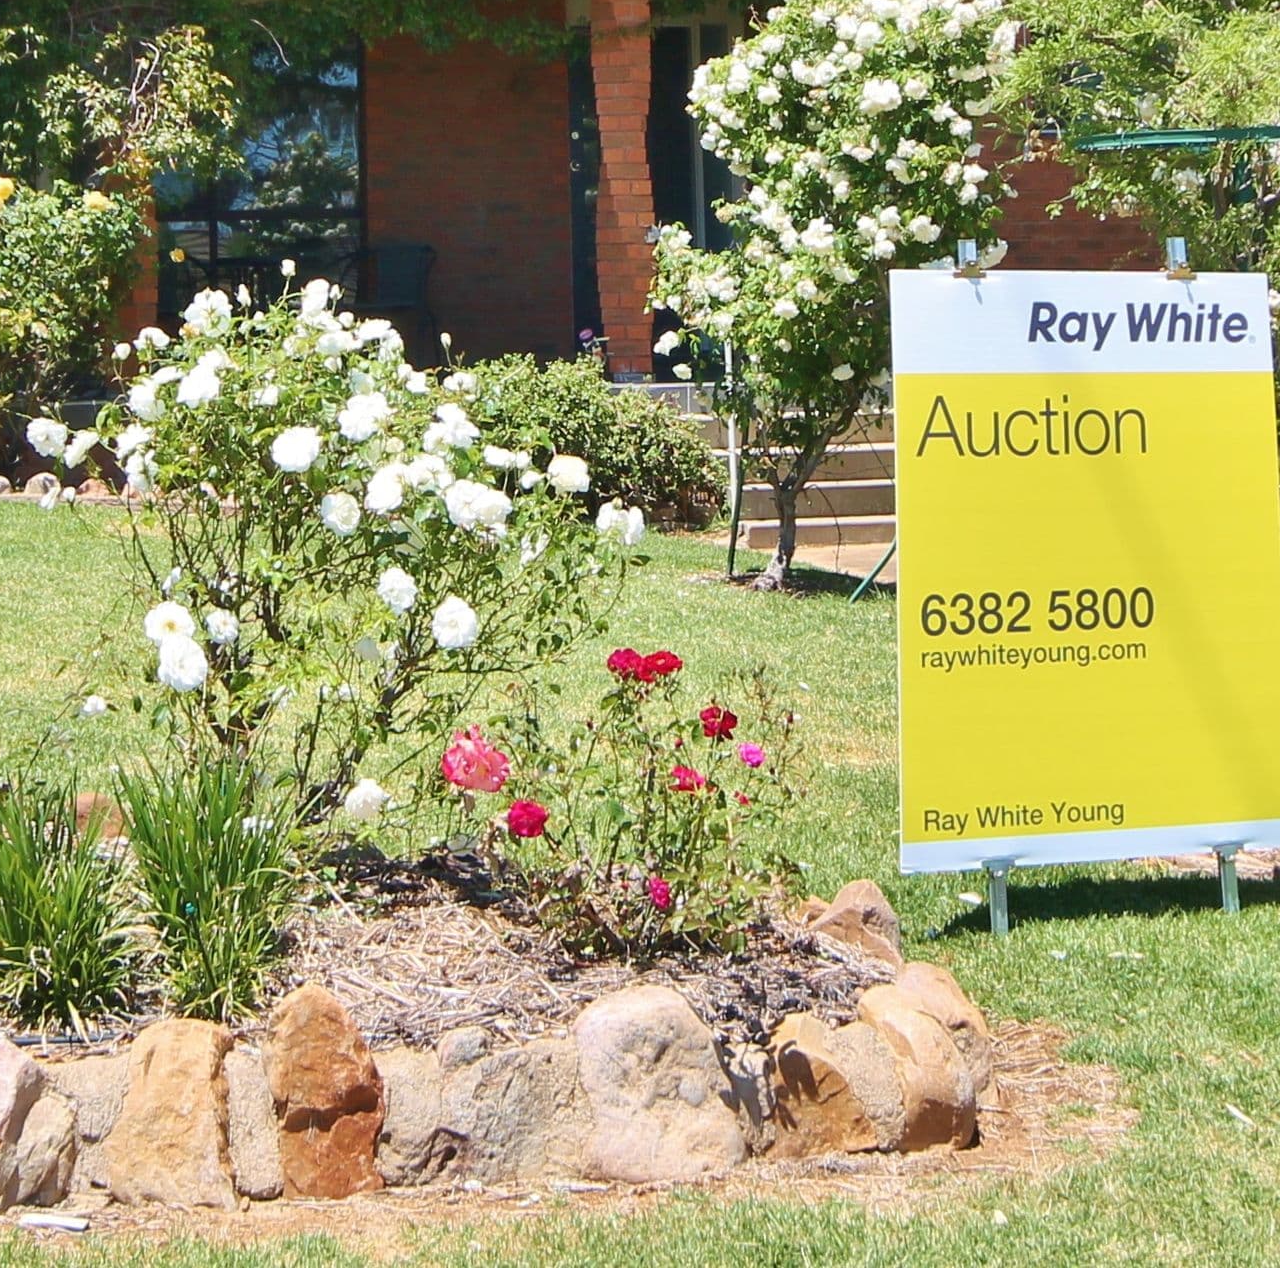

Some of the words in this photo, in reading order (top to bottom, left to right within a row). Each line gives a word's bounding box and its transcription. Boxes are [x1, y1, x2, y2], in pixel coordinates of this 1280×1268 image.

[1027, 301, 1117, 352] Ray
[1125, 302, 1249, 344] White
[916, 394, 1147, 458] Auction
[921, 590, 1032, 637] 6382
[1048, 586, 1154, 632] 5800
[921, 642, 1147, 673] raywhiteyoung.com
[924, 809, 969, 836] Ray
[976, 804, 1044, 829] White
[1050, 801, 1124, 826] Young
